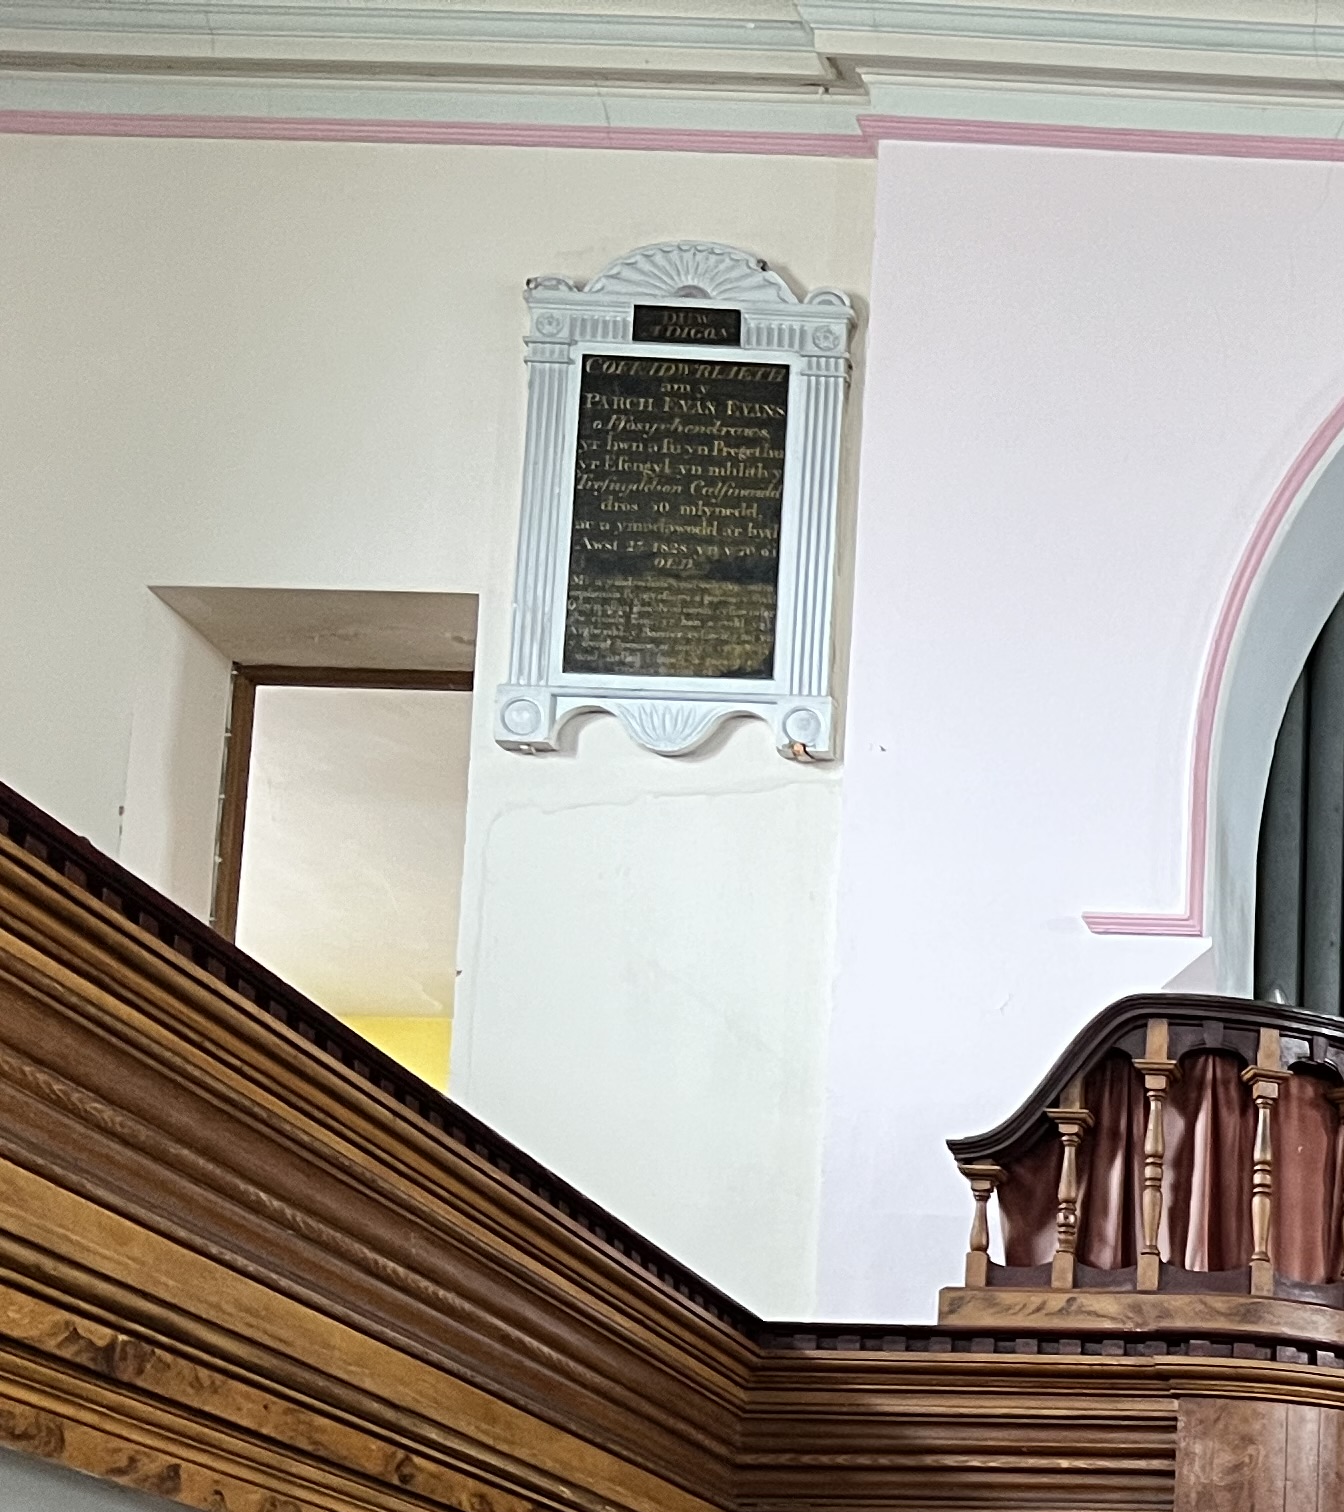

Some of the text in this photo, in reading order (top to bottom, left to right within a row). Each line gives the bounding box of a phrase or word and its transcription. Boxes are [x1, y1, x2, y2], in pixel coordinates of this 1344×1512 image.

[585, 392, 785, 418] PARCH EVAN EVANS
[606, 434, 644, 451] hwn
[684, 444, 709, 459] yn
[604, 455, 670, 478] Efengyl
[677, 463, 701, 479] yn
[600, 496, 639, 511] dros
